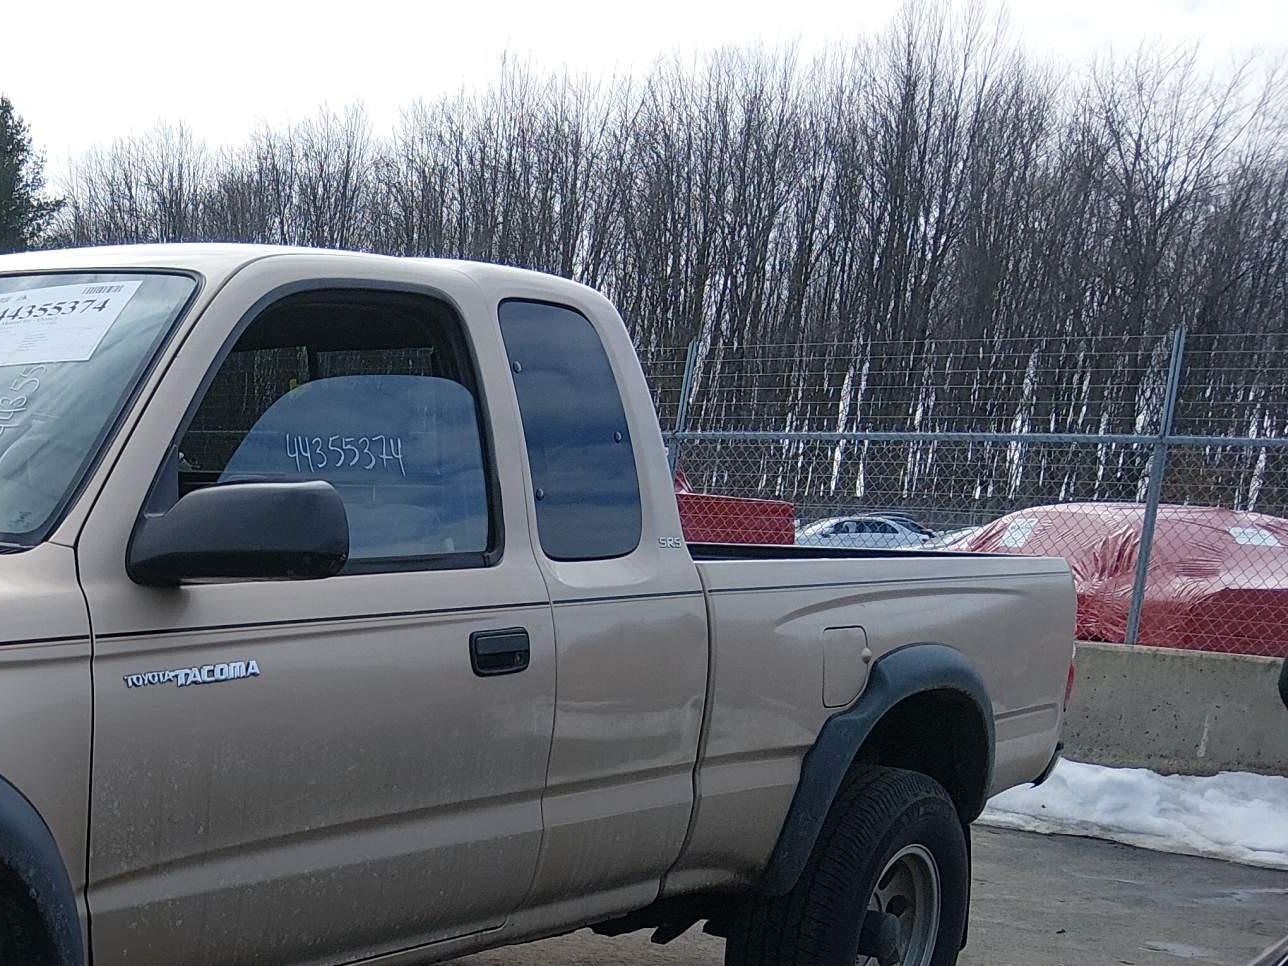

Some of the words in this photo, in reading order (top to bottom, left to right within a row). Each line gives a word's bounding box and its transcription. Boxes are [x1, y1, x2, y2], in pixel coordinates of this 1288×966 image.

[285, 433, 407, 477] 44355374
[123, 671, 174, 688] TOYOTA
[172, 659, 261, 687] TACOMA
